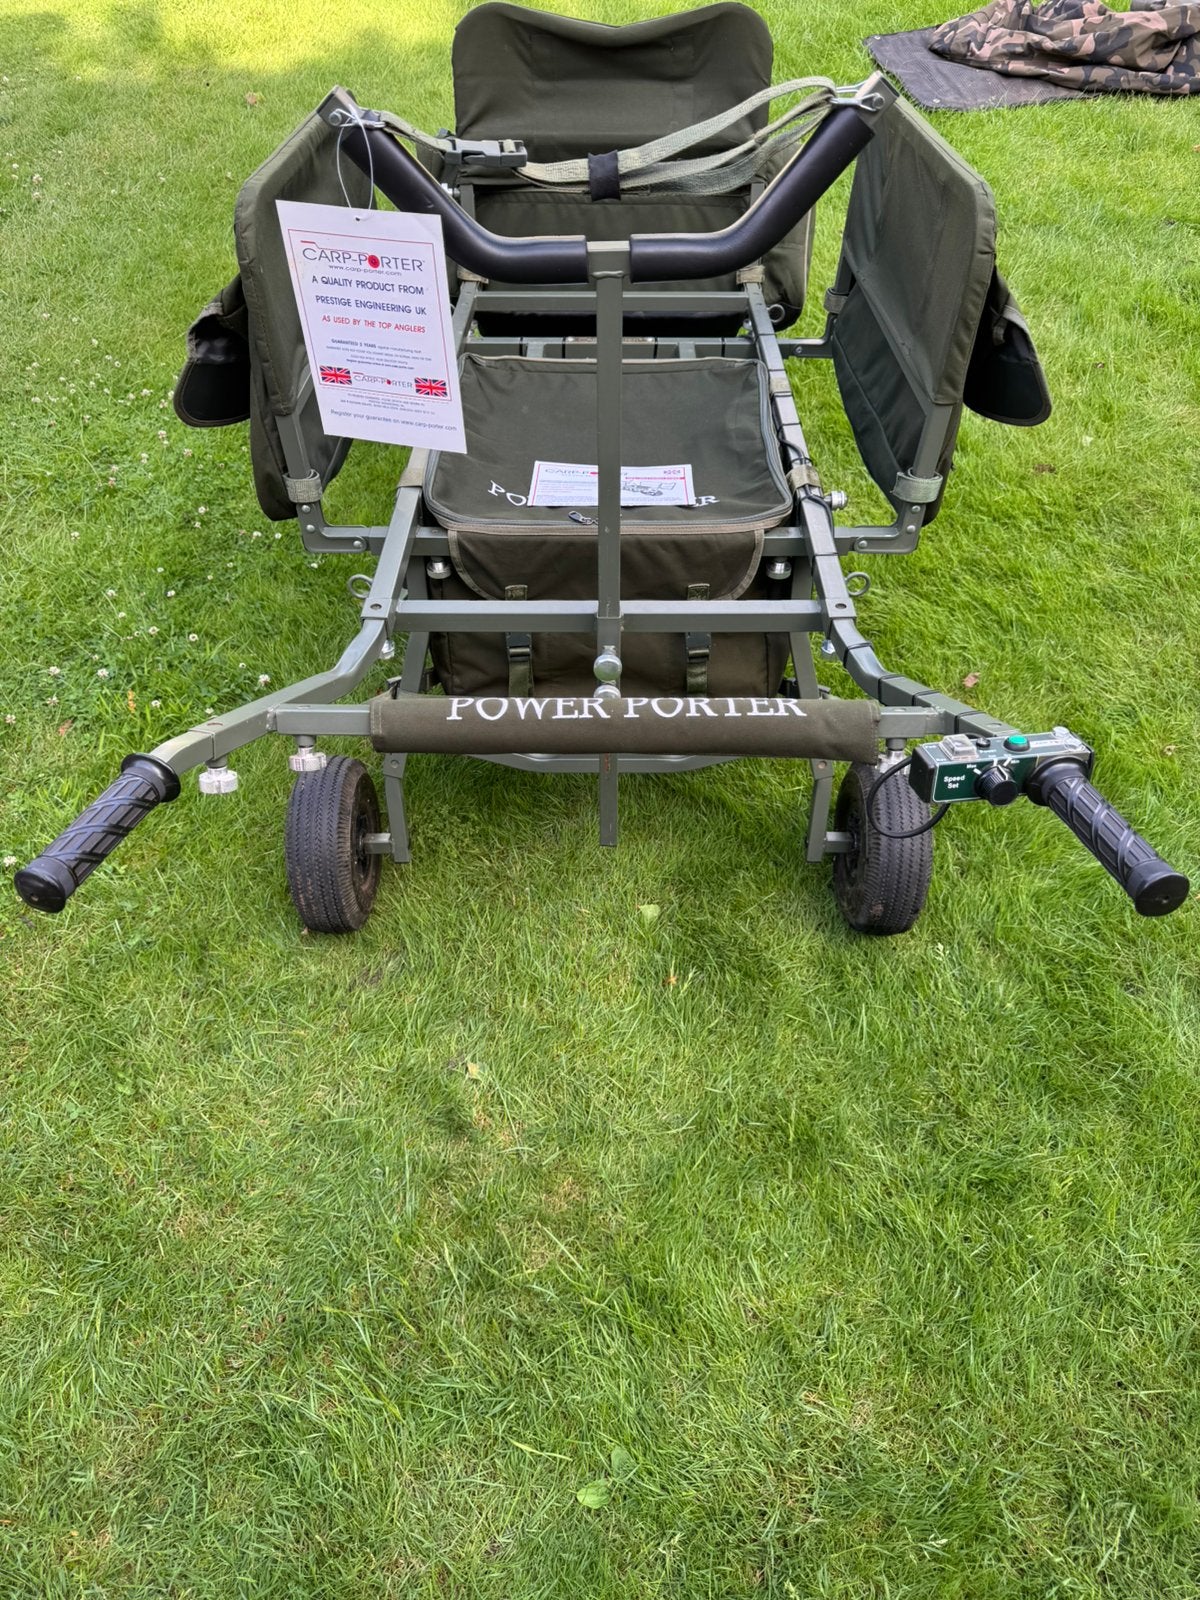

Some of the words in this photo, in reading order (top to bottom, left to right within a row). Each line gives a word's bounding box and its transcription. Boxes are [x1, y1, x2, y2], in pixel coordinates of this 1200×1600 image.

[302, 248, 423, 272] CARP-PORTER
[329, 265, 402, 276] www.carp-porter.com
[311, 275, 319, 284] A
[321, 276, 353, 288] QUALITY
[356, 280, 395, 292] PRODUCT
[398, 285, 425, 295] FROM
[315, 295, 352, 307] PRESTIGE
[355, 299, 412, 314] ENGINEERING
[415, 306, 427, 316] UK
[322, 315, 331, 323] AS
[333, 316, 350, 325] USED
[353, 318, 361, 326] BY
[364, 320, 376, 328] THE
[379, 321, 392, 329] TOP
[394, 323, 426, 334] ANGLERS
[354, 374, 413, 388] CARP-PORTER
[330, 408, 352, 418] Register
[446, 697, 611, 721] POWER
[623, 697, 807, 718] PORTER
[943, 774, 966, 783] Speed
